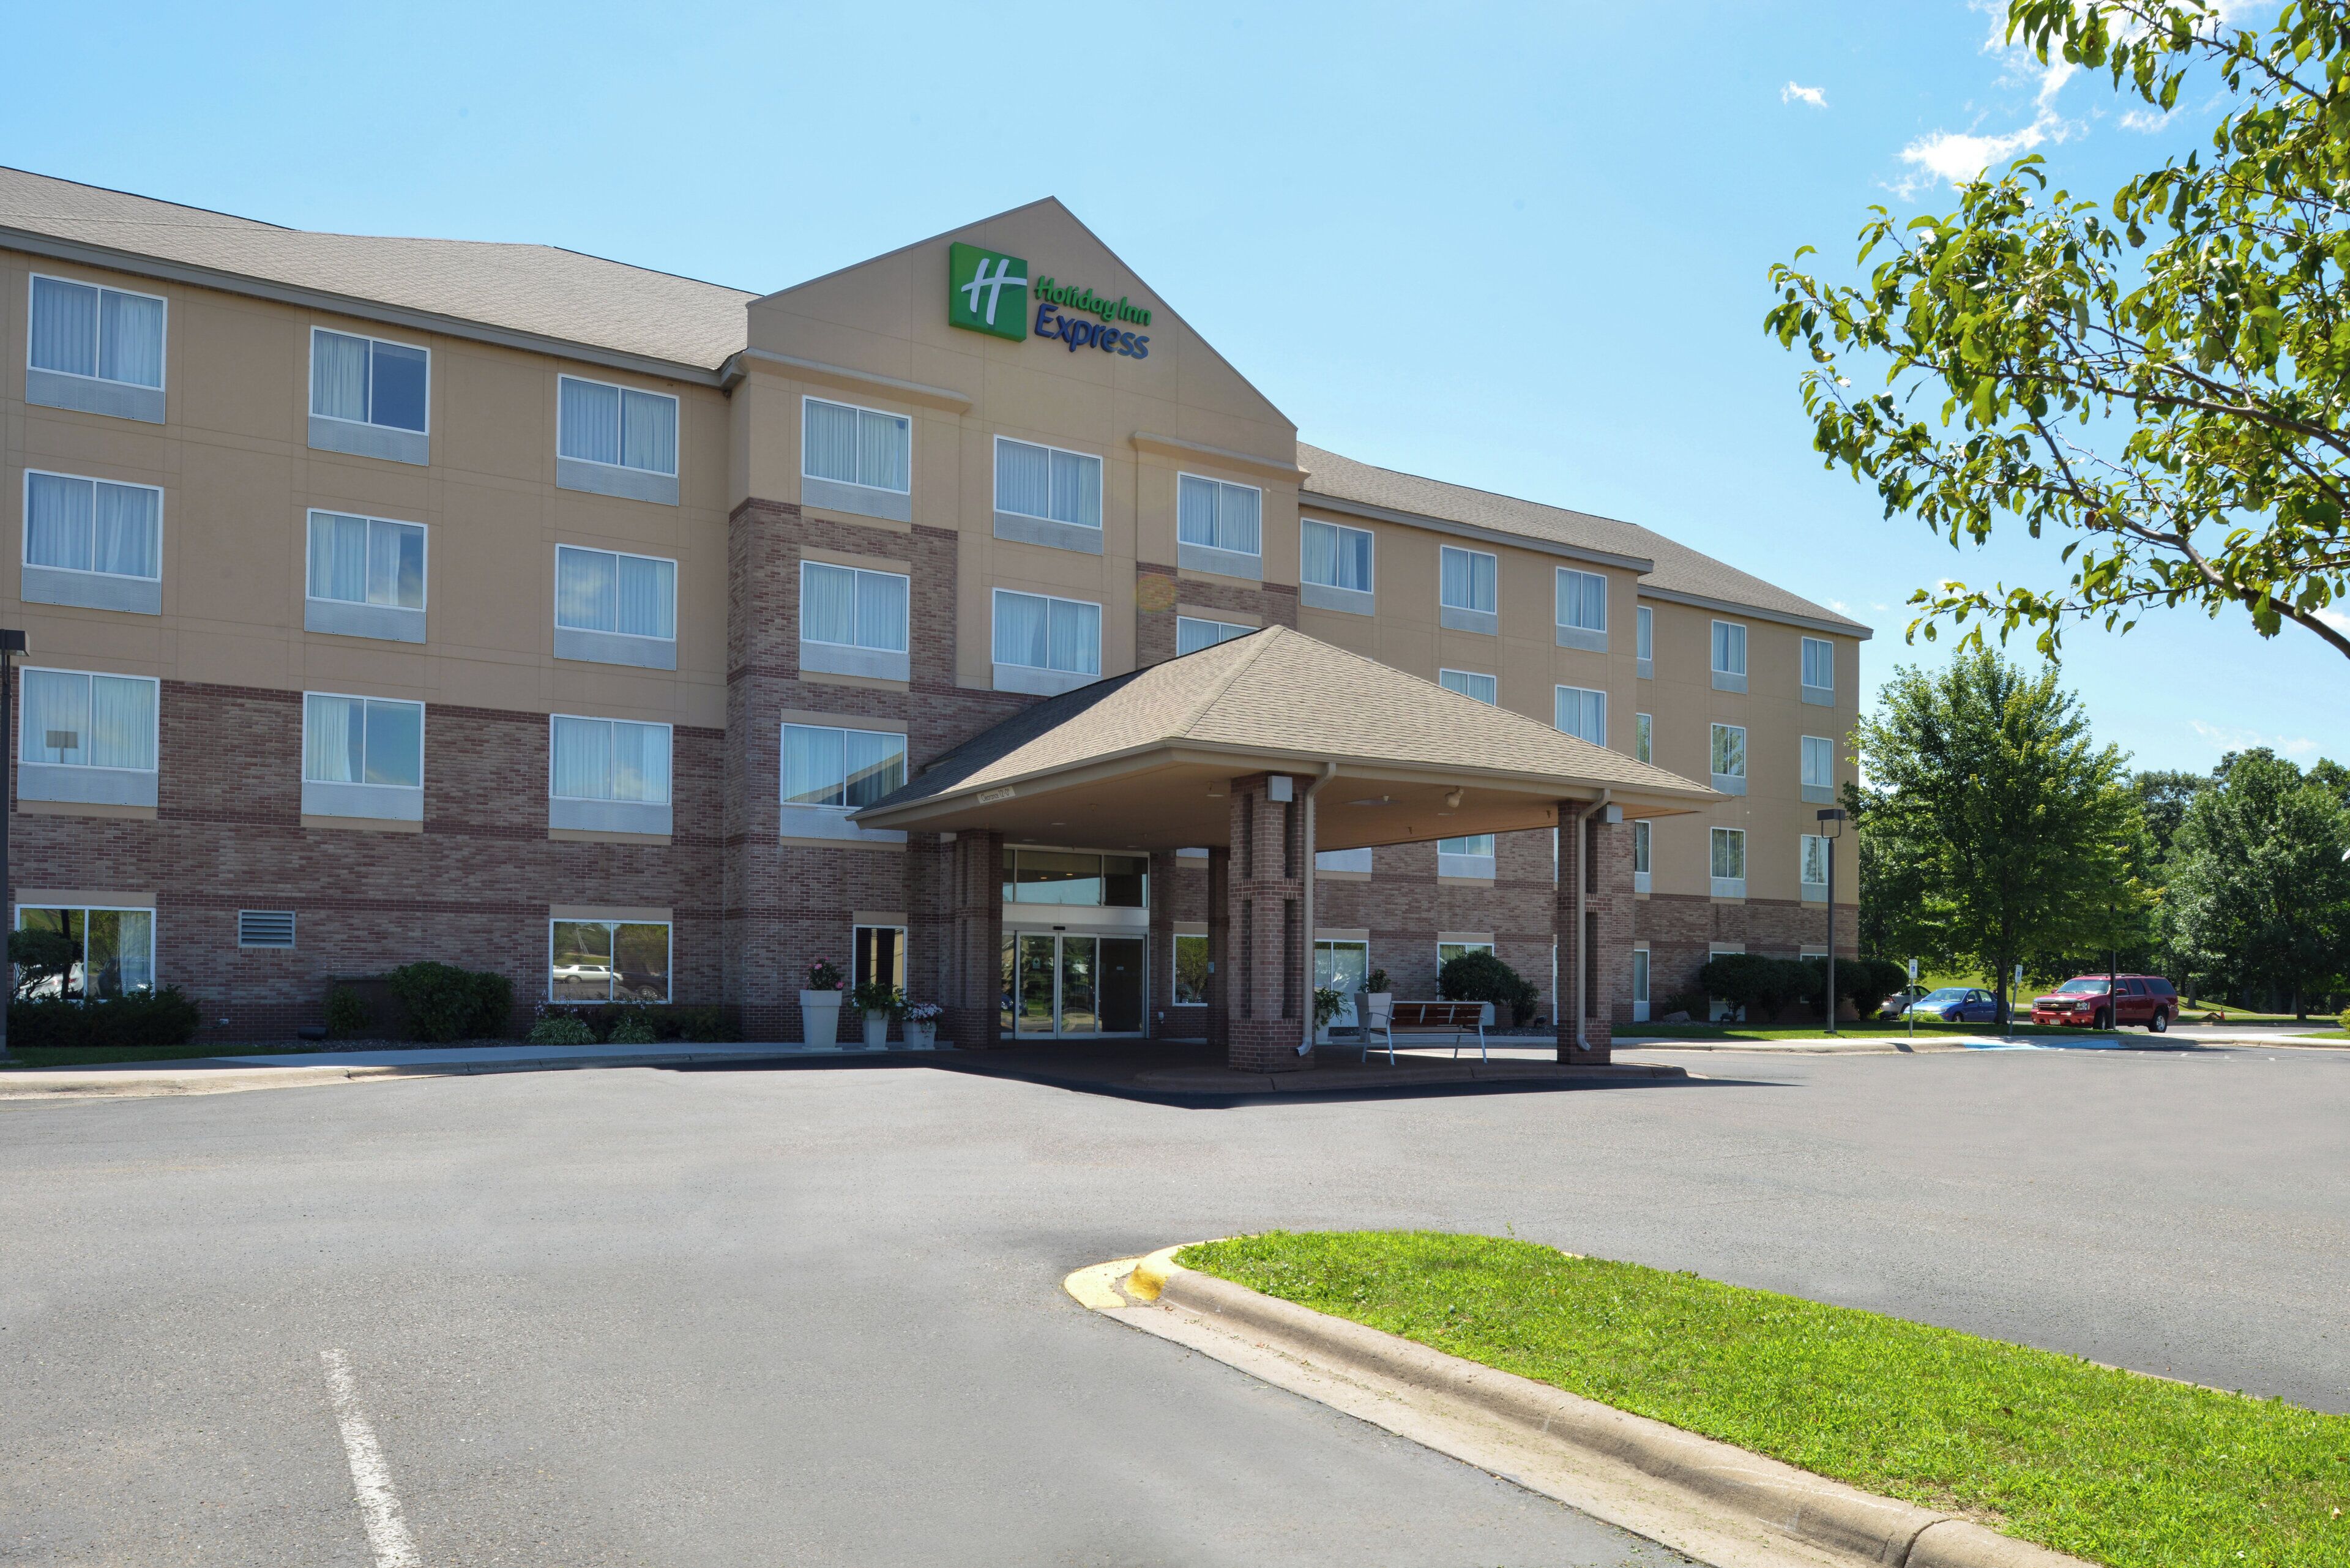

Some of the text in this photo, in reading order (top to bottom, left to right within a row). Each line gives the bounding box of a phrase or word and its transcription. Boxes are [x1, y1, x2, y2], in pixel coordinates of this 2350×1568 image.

[1034, 275, 1152, 326] Holiday Inn
[1034, 303, 1150, 360] Express
[980, 793, 999, 802] Clearance
